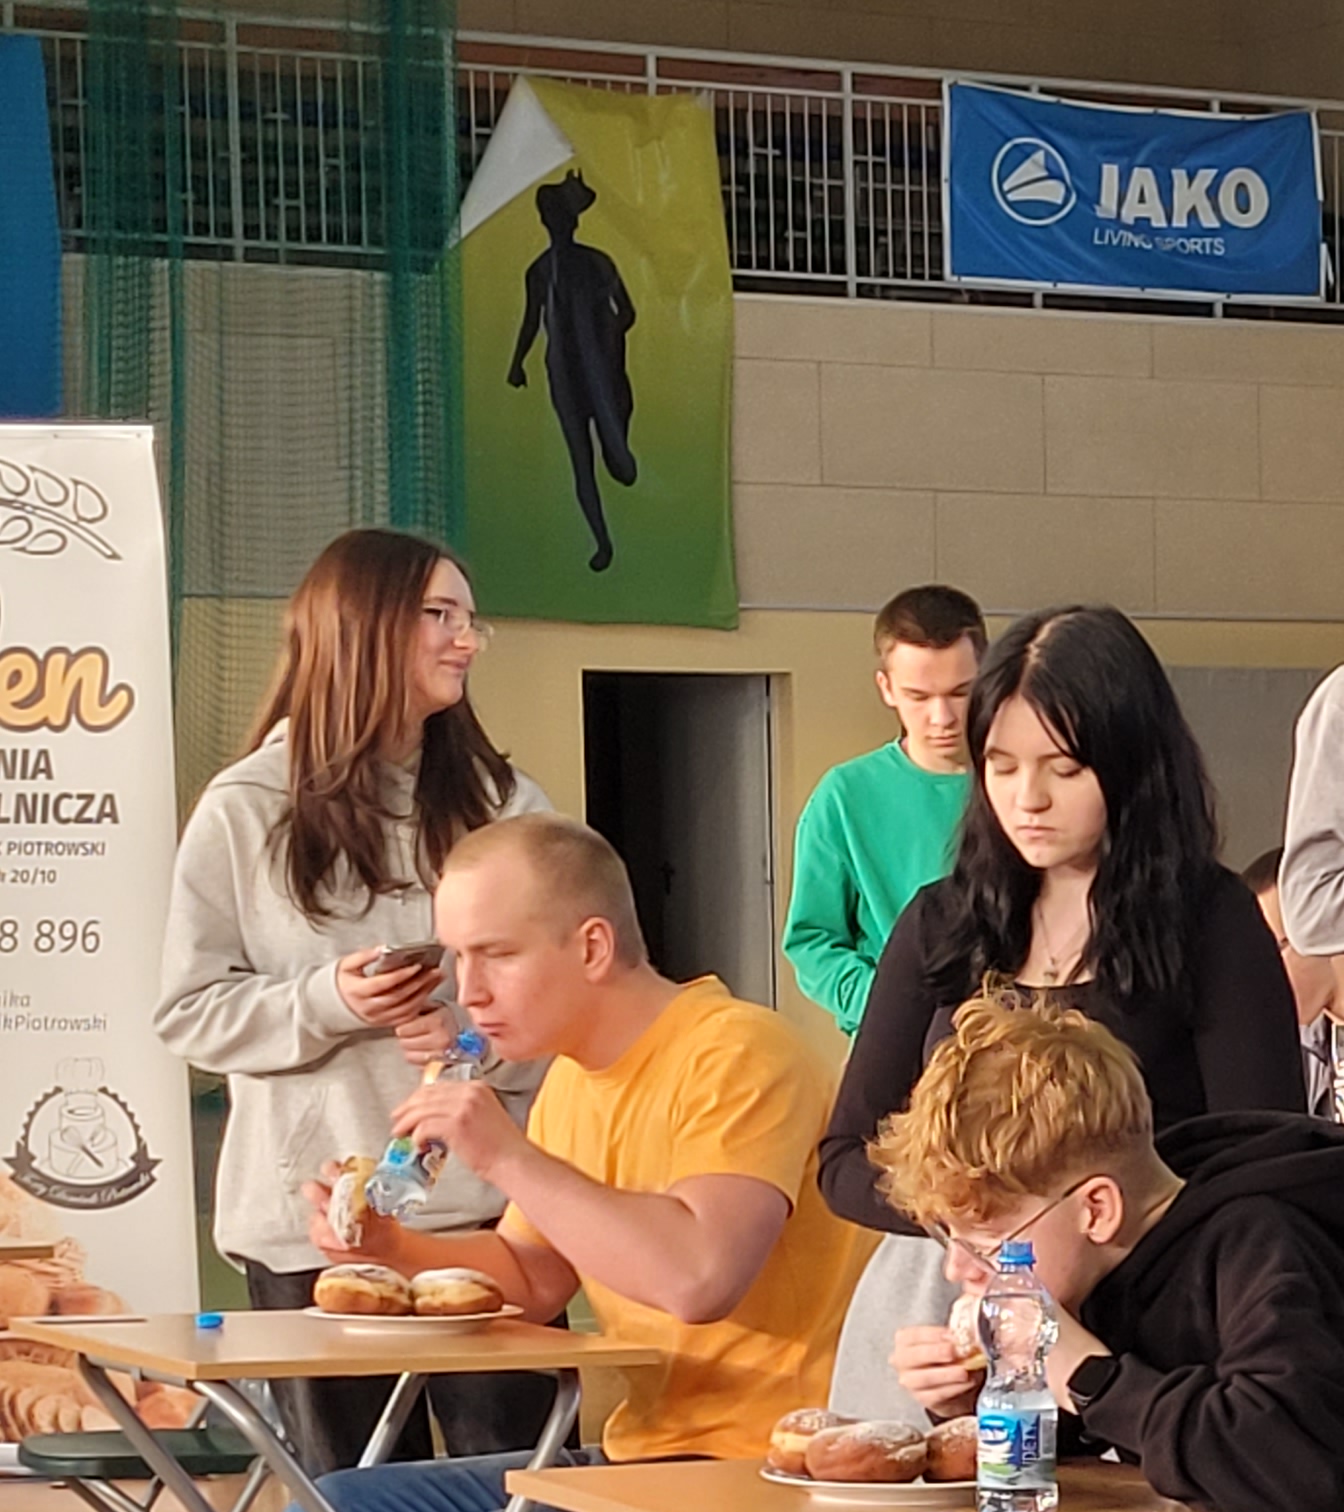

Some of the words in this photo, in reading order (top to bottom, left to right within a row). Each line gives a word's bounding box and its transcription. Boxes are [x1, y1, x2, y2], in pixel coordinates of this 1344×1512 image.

[1094, 163, 1270, 229] JAKO
[7, 840, 106, 857] PIOTROWSKI
[10, 867, 58, 886] 20/10
[34, 918, 101, 953] 896
